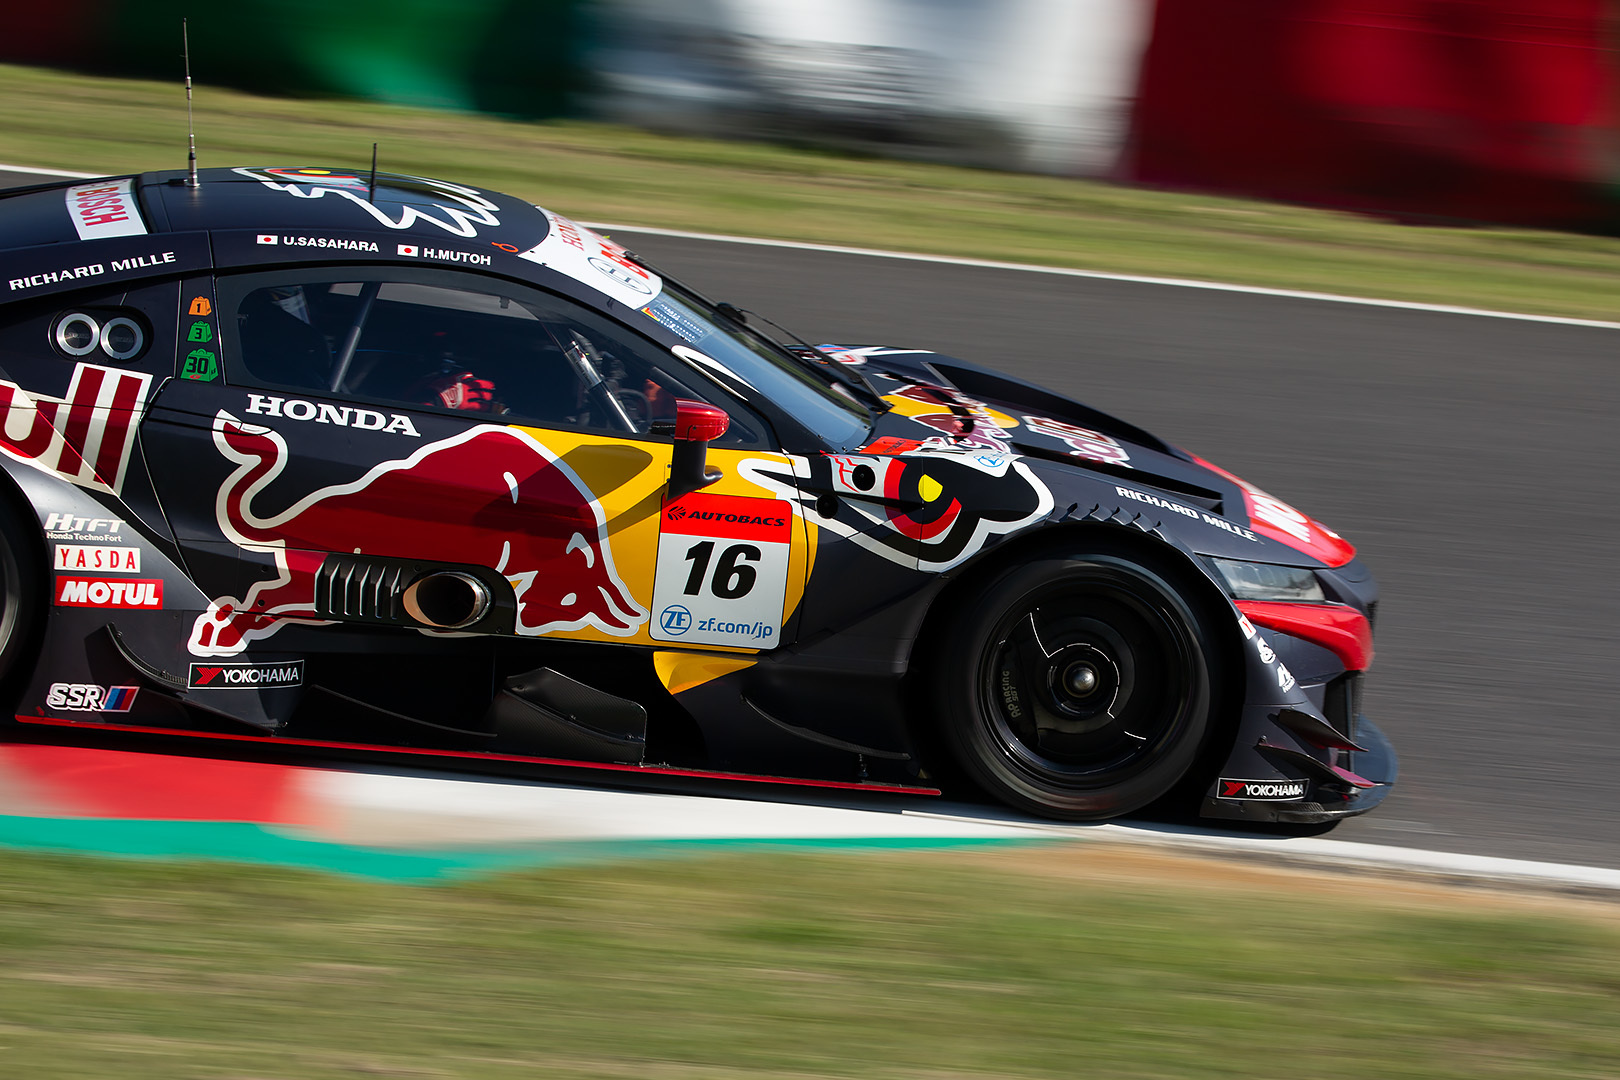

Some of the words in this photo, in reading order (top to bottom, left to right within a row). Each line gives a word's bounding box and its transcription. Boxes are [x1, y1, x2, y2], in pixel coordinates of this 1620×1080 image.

[76, 186, 129, 227] BOSCH
[283, 235, 379, 253] U.SASAHARA
[423, 247, 491, 266] H.MUTOH
[9, 263, 104, 291] RICHARD
[111, 252, 177, 271] MILLE
[196, 303, 201, 313] 1
[194, 328, 202, 339] 3
[186, 356, 208, 374] 30
[245, 393, 421, 437] HONDA
[688, 511, 785, 527] AUTOBACS
[1115, 486, 1199, 520] RICHARD
[1202, 514, 1257, 542] MILLE
[46, 532, 73, 540] Honda
[73, 533, 104, 541] Techno
[104, 534, 122, 542] Fort
[61, 548, 136, 570] YASDA
[683, 541, 761, 599] 16
[60, 580, 159, 605] MOTUL
[662, 607, 690, 632] ZF
[698, 617, 773, 640] zf.com/jp
[223, 667, 299, 683] YOKOHAMA
[46, 683, 106, 711] SSR
[1245, 784, 1303, 797] YOKOHAMA
